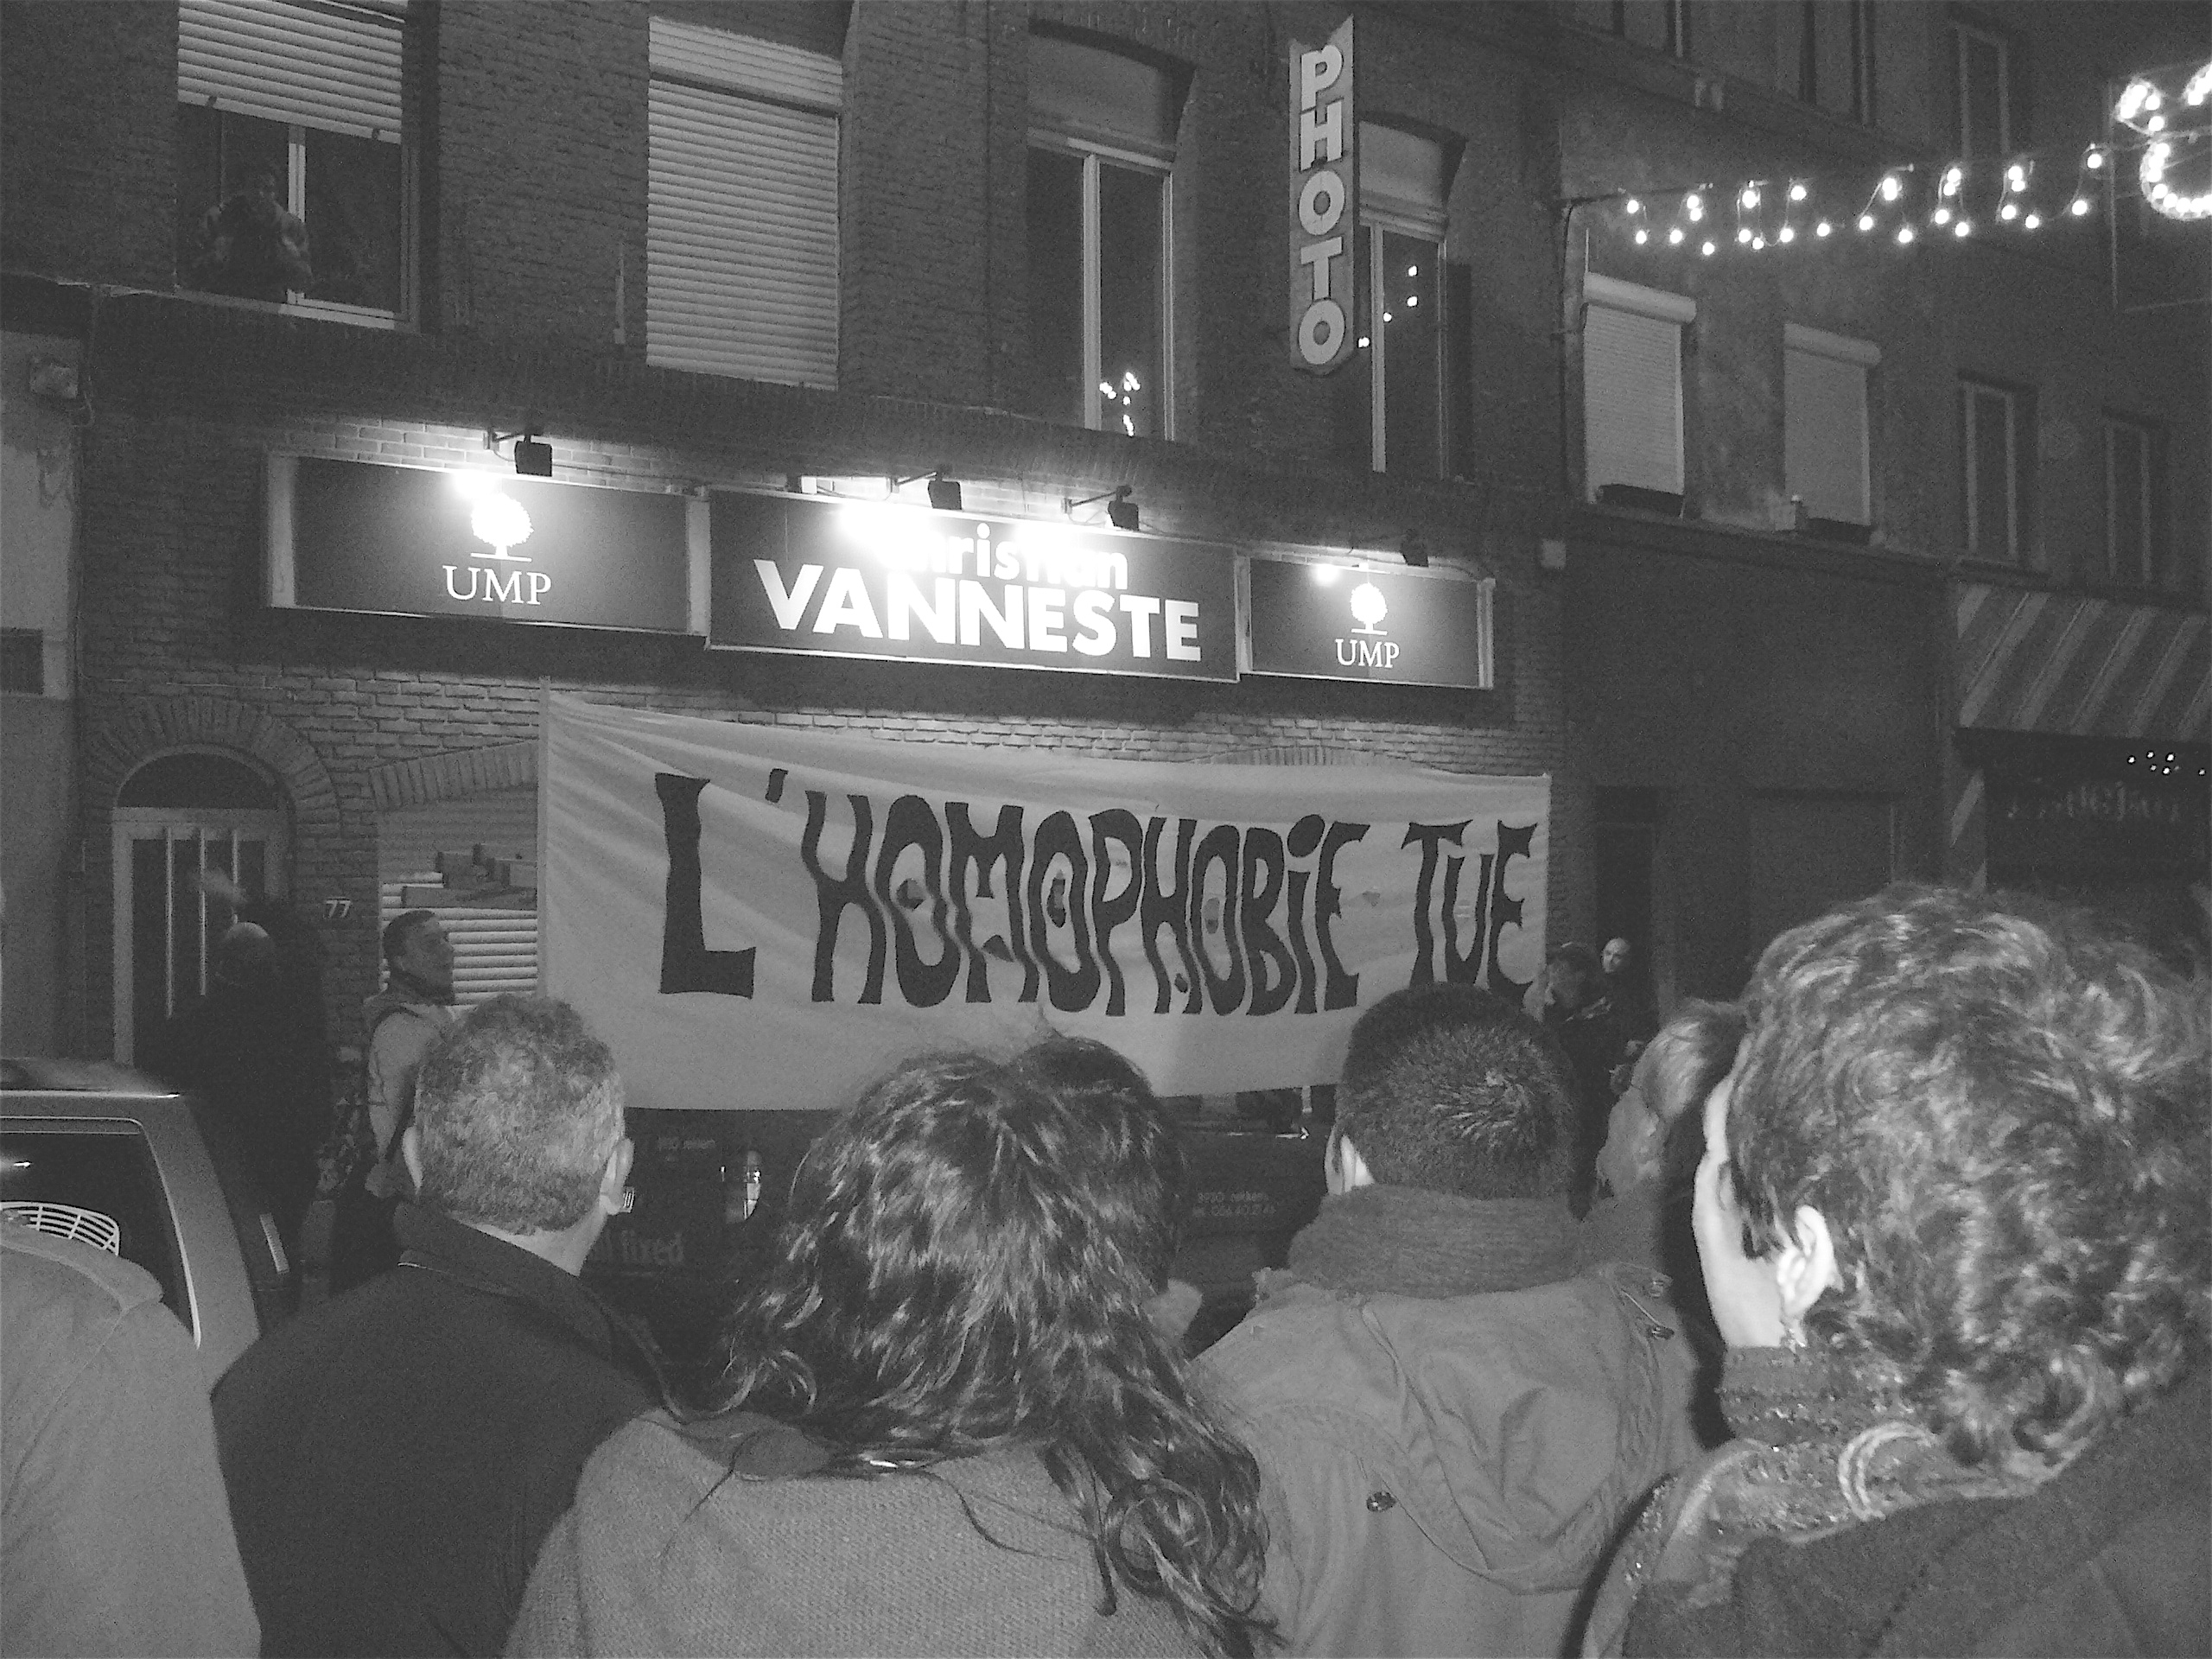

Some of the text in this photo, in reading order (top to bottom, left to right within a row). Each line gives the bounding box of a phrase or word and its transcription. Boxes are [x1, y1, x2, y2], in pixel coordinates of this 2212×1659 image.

[1298, 44, 1345, 365] PHOTO
[442, 564, 552, 605] UMP
[871, 517, 1128, 590] hristian
[753, 559, 1202, 662] VANNESTE
[1335, 638, 1400, 669] UMP
[325, 899, 351, 918] 77
[1401, 819, 1539, 1002] TUE
